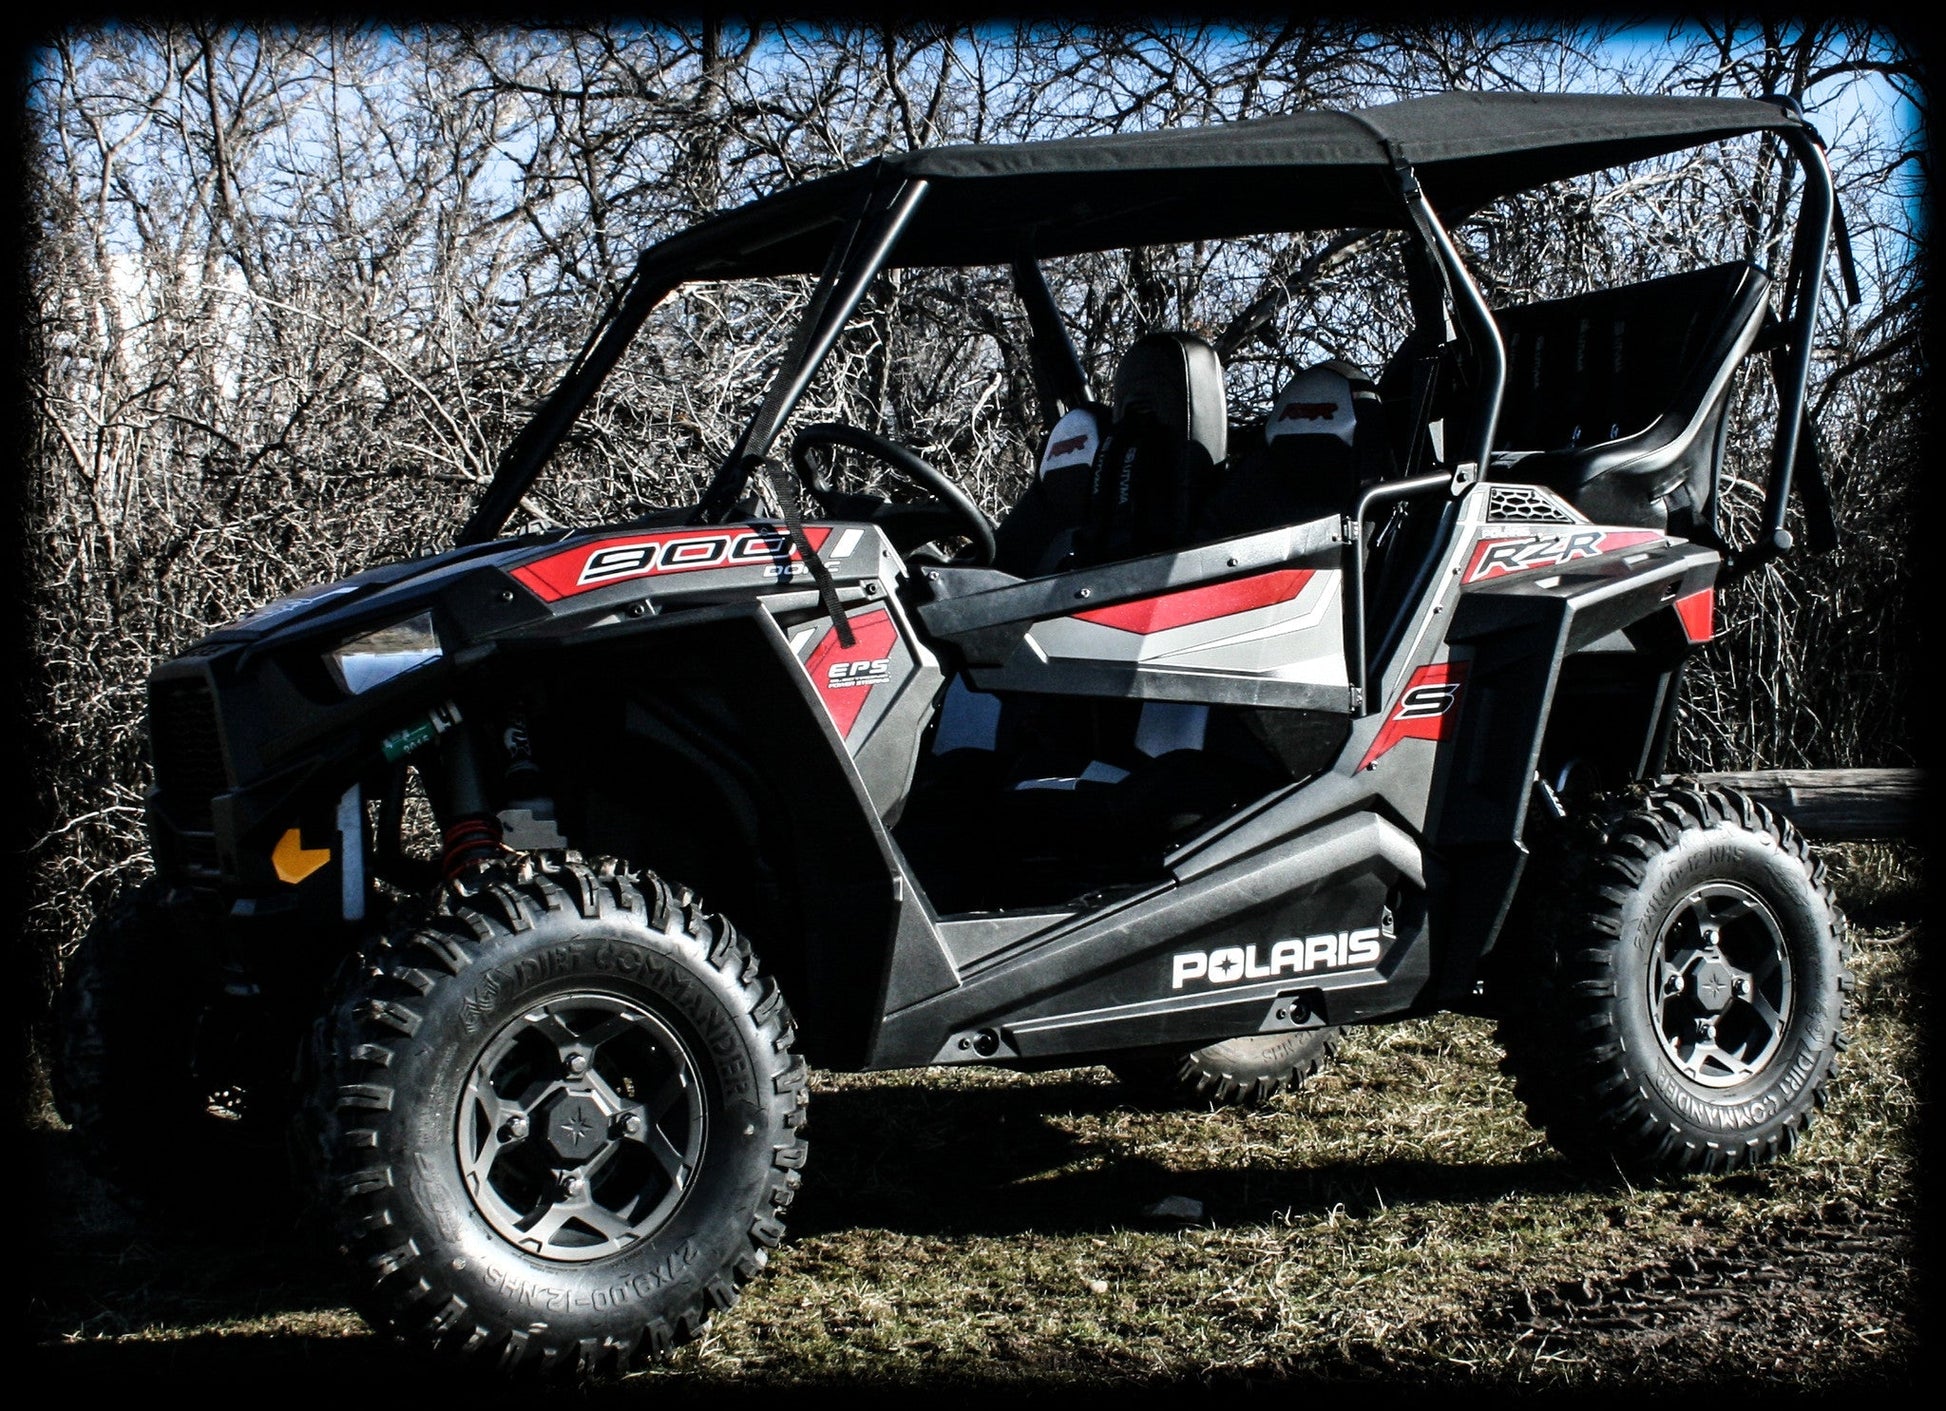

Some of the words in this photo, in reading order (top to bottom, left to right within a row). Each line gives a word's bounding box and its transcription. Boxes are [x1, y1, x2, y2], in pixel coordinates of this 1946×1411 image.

[763, 561, 841, 578] DOC
[1469, 531, 1606, 582] RZR
[828, 658, 890, 678] EPS
[1393, 683, 1461, 721] S
[1172, 928, 1381, 989] POLARIS
[515, 946, 581, 987] DIRT
[595, 945, 750, 1096] COMMANDER
[1656, 1056, 1781, 1130] COMMANDER
[1779, 1051, 1816, 1102] DIRT
